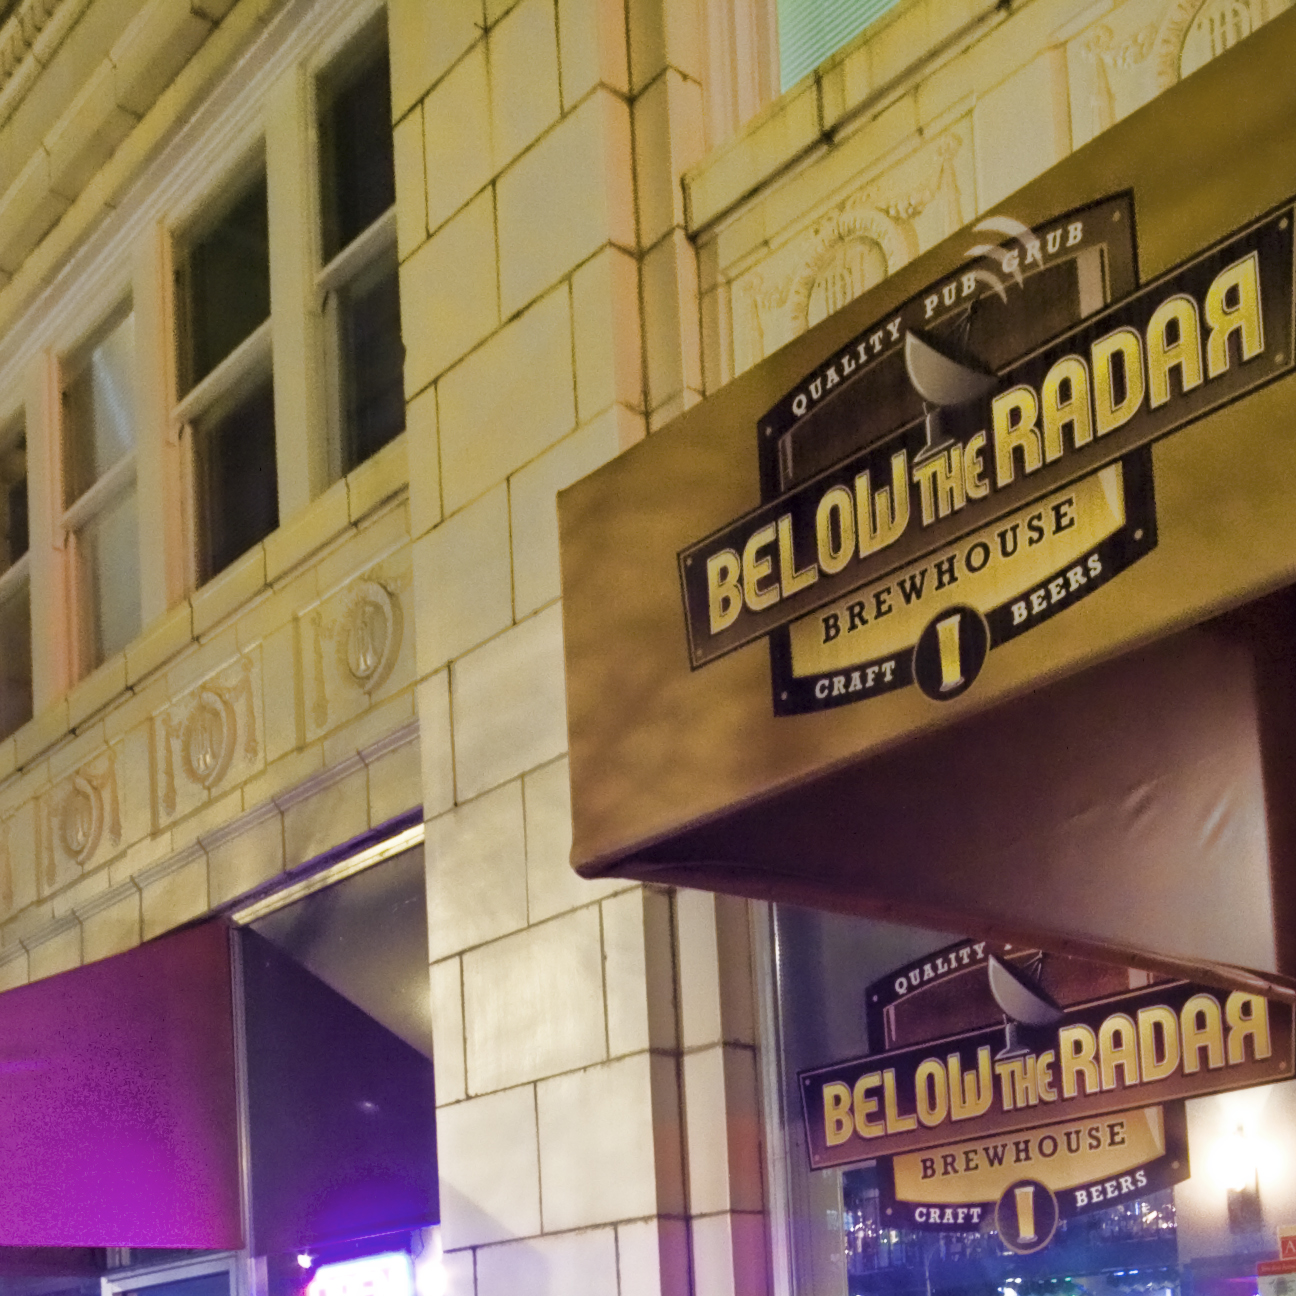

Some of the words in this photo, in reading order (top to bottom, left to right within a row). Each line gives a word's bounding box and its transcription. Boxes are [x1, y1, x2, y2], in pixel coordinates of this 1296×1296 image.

[792, 317, 904, 416] QUALITY
[923, 271, 979, 321] PUB
[1001, 220, 1085, 273] GRUB
[706, 449, 910, 635] BELOW
[914, 434, 991, 527] THE
[992, 250, 1265, 488] RADAR
[813, 660, 898, 700] CRAFT
[1010, 553, 1104, 626] BEERS
[821, 497, 1076, 644] BREWHOUSE
[894, 941, 987, 996] QUALITY
[821, 1044, 994, 1149] BELOW
[994, 1048, 1057, 1113] THE
[920, 1121, 1127, 1180] BREWHOUSE
[914, 1206, 982, 1226] CRAFT
[1075, 1170, 1149, 1207] BEERS
